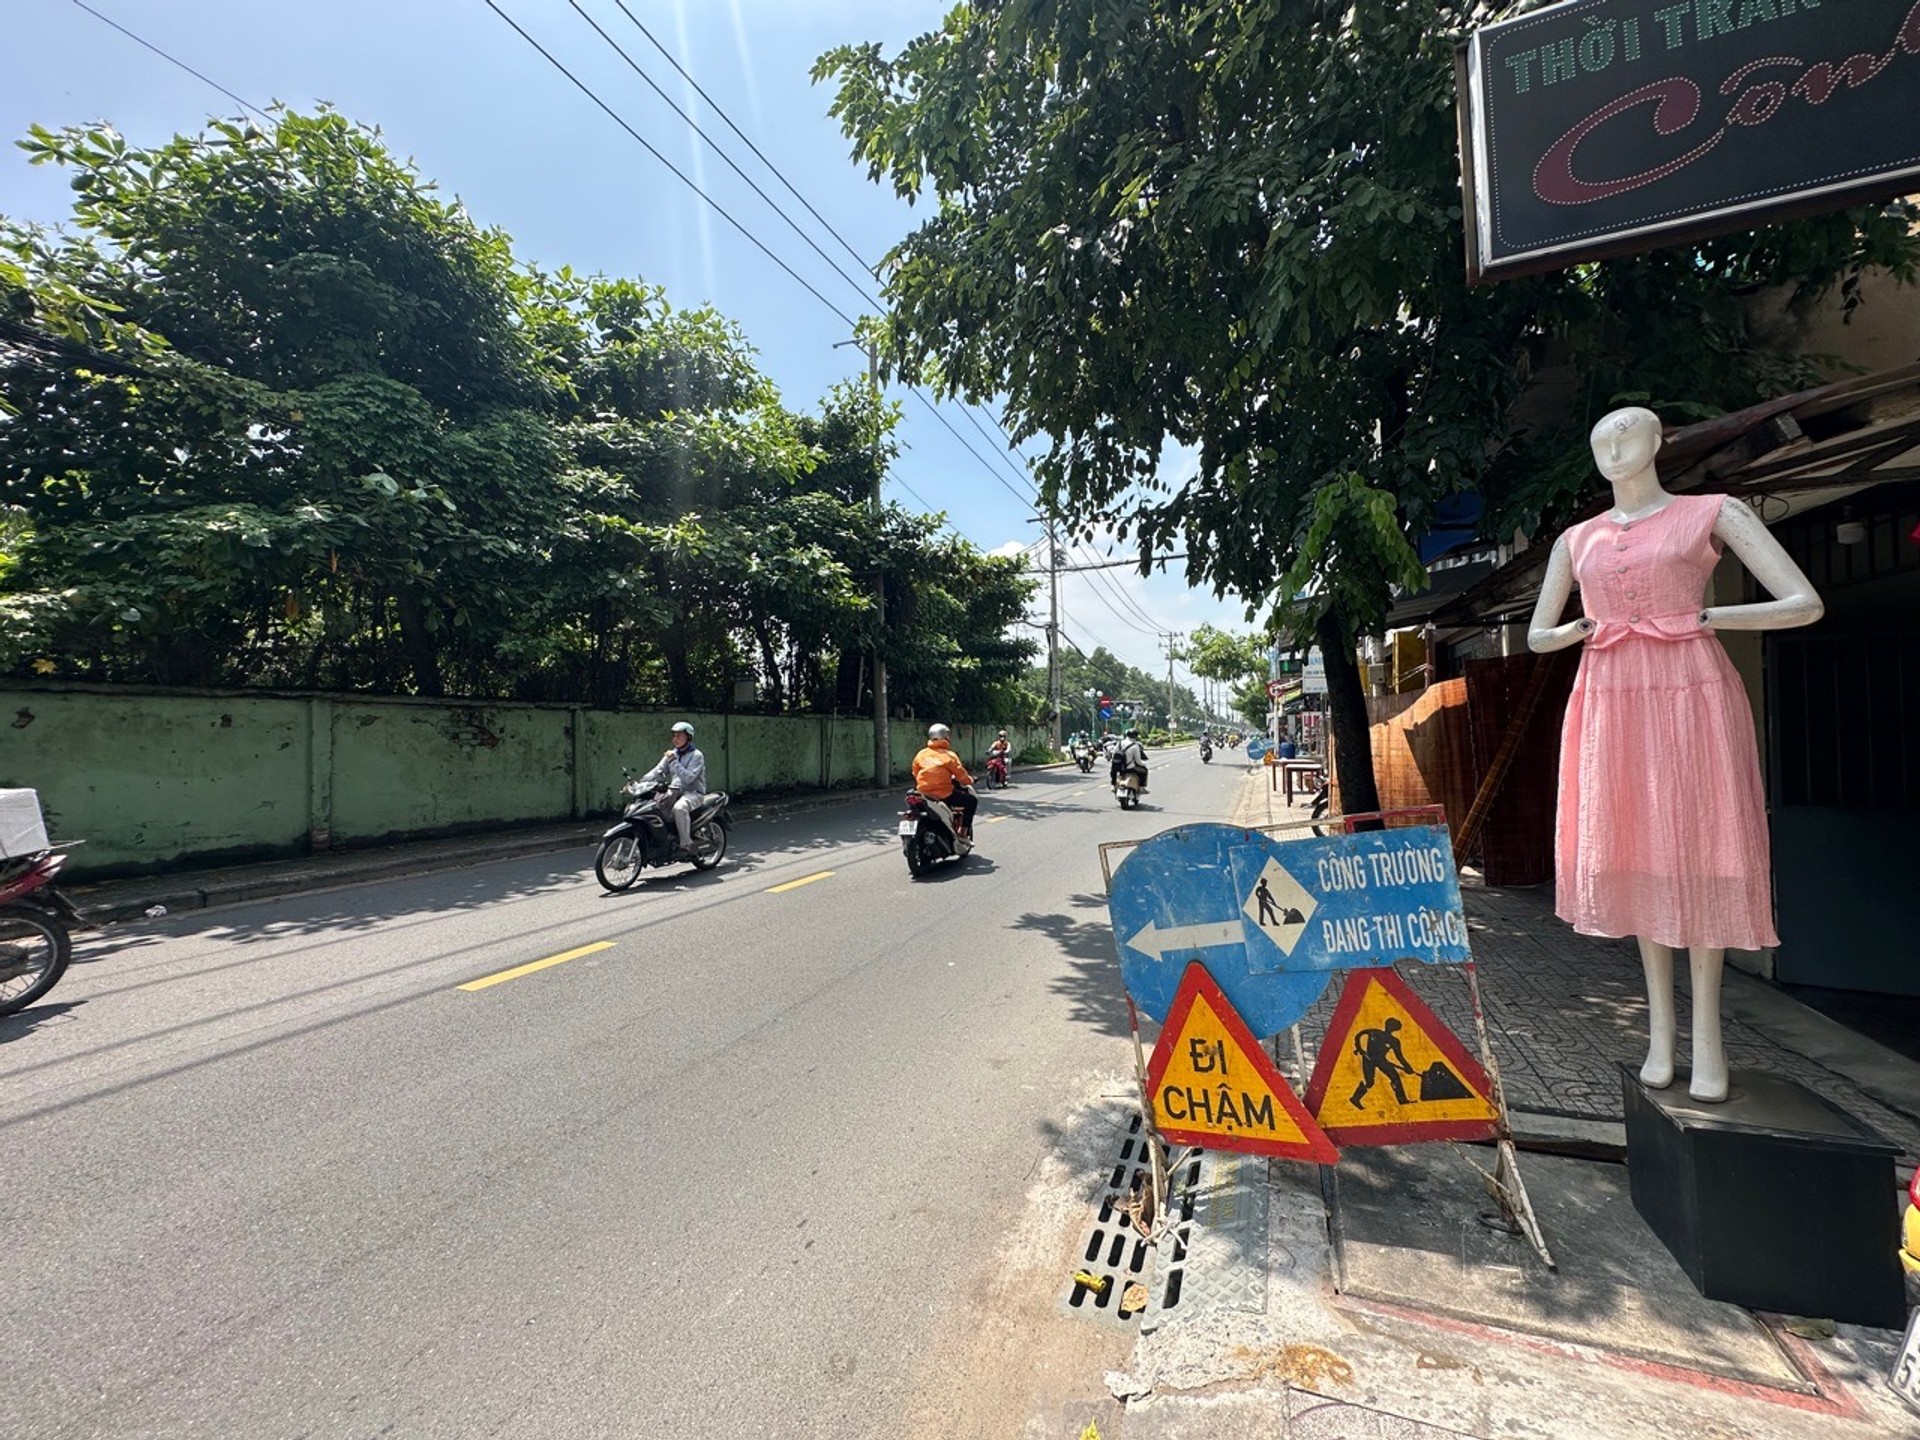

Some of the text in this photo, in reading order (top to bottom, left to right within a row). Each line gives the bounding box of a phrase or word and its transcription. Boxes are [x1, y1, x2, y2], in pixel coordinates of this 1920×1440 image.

[1505, 15, 1642, 94] THỜI
[1318, 841, 1445, 892] CÔNG TRƯỜNG
[1322, 916, 1371, 953] ĐANG
[1373, 914, 1405, 950] THI
[1189, 1038, 1227, 1075] ĐI
[1163, 1082, 1276, 1131] CHẬM
